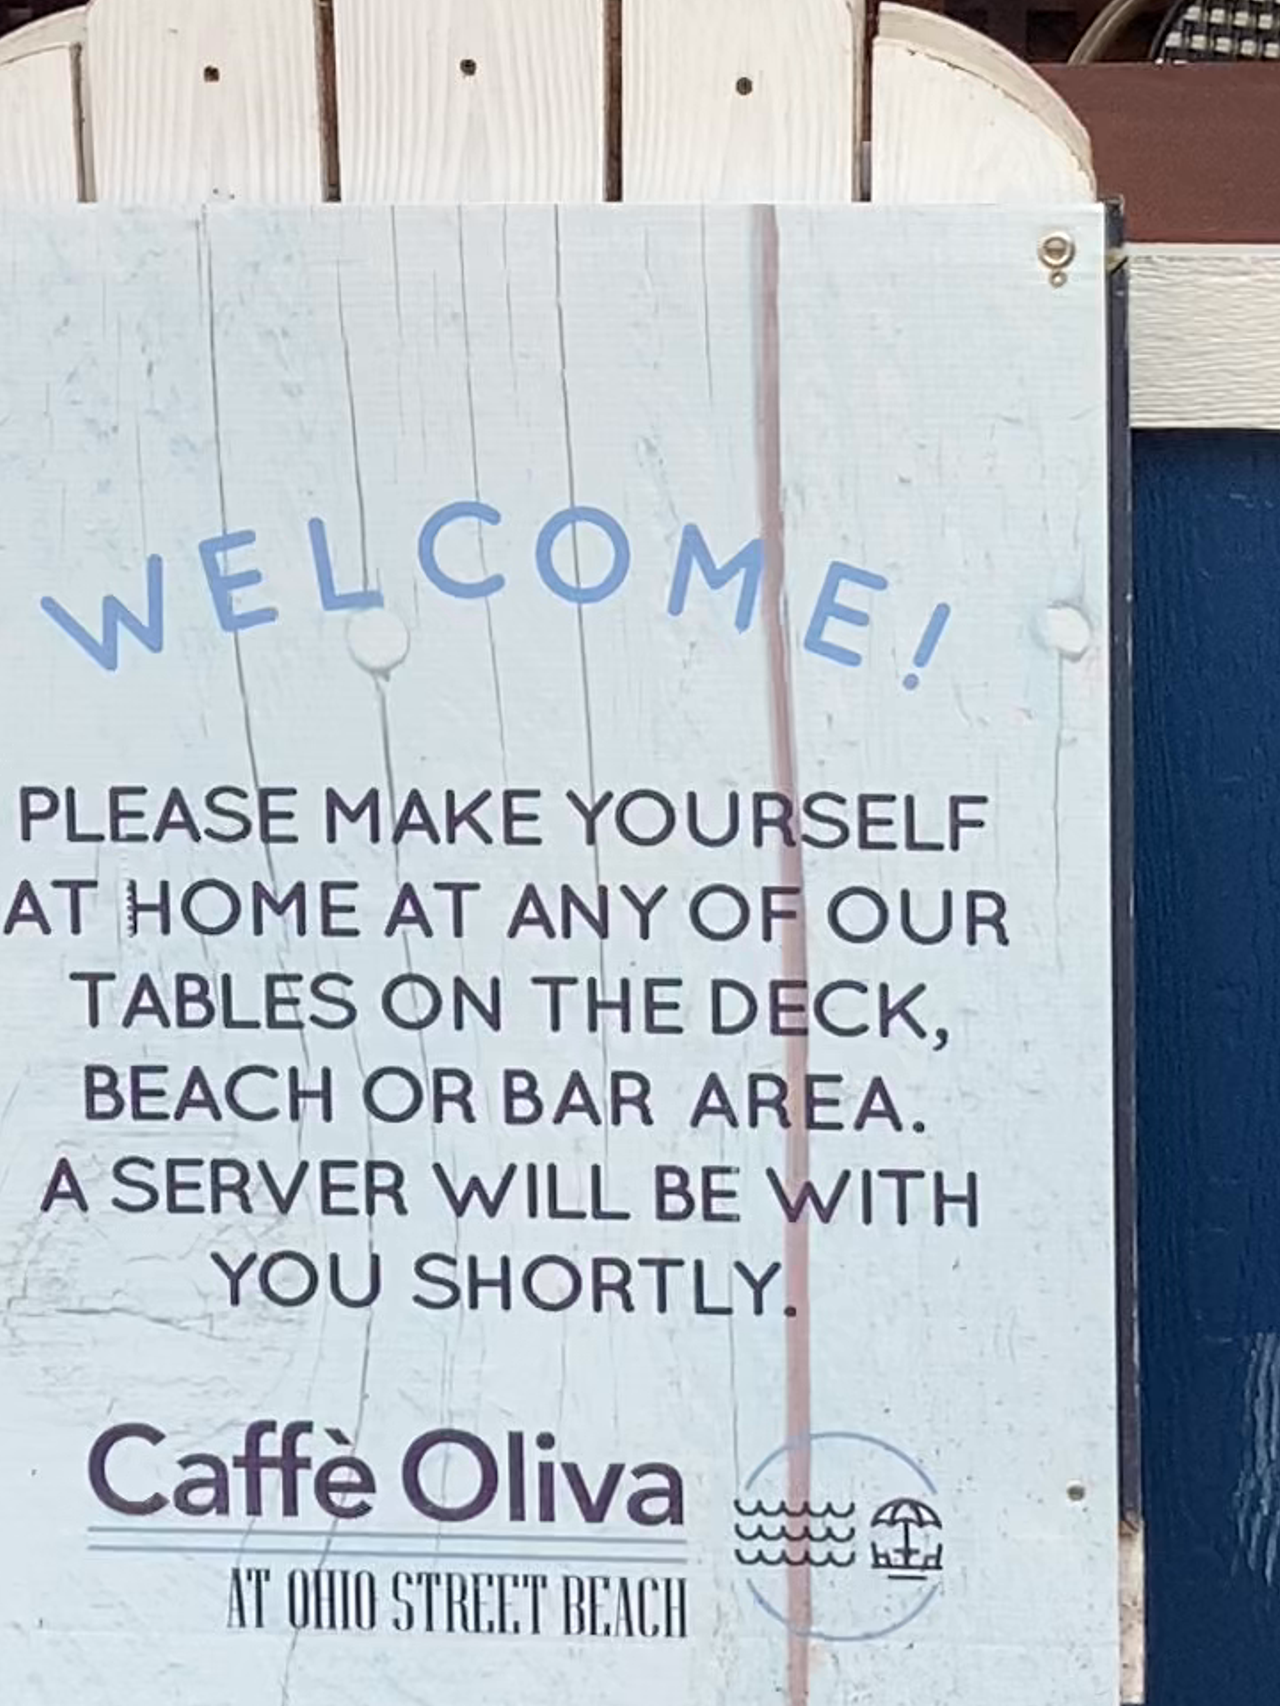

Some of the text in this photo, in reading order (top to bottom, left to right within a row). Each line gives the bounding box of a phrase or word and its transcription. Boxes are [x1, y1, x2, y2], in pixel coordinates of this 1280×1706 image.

[40, 500, 951, 691] WELCOME!
[19, 786, 990, 853] PLEASE MAKE YOURSELF
[2, 878, 1011, 948] AT HOME AT ANY OF OUR
[68, 970, 951, 1053] TABLES ON THE DECK,
[82, 1063, 928, 1135] BEACH OR BAR AREA.
[38, 1155, 980, 1229] A SERVER WILL BE WITH
[209, 1249, 800, 1319] YOU SHORTLY.
[86, 1418, 687, 1528] Caffè Oliva
[225, 1566, 689, 1640] AT OHIO STREET BEACH
